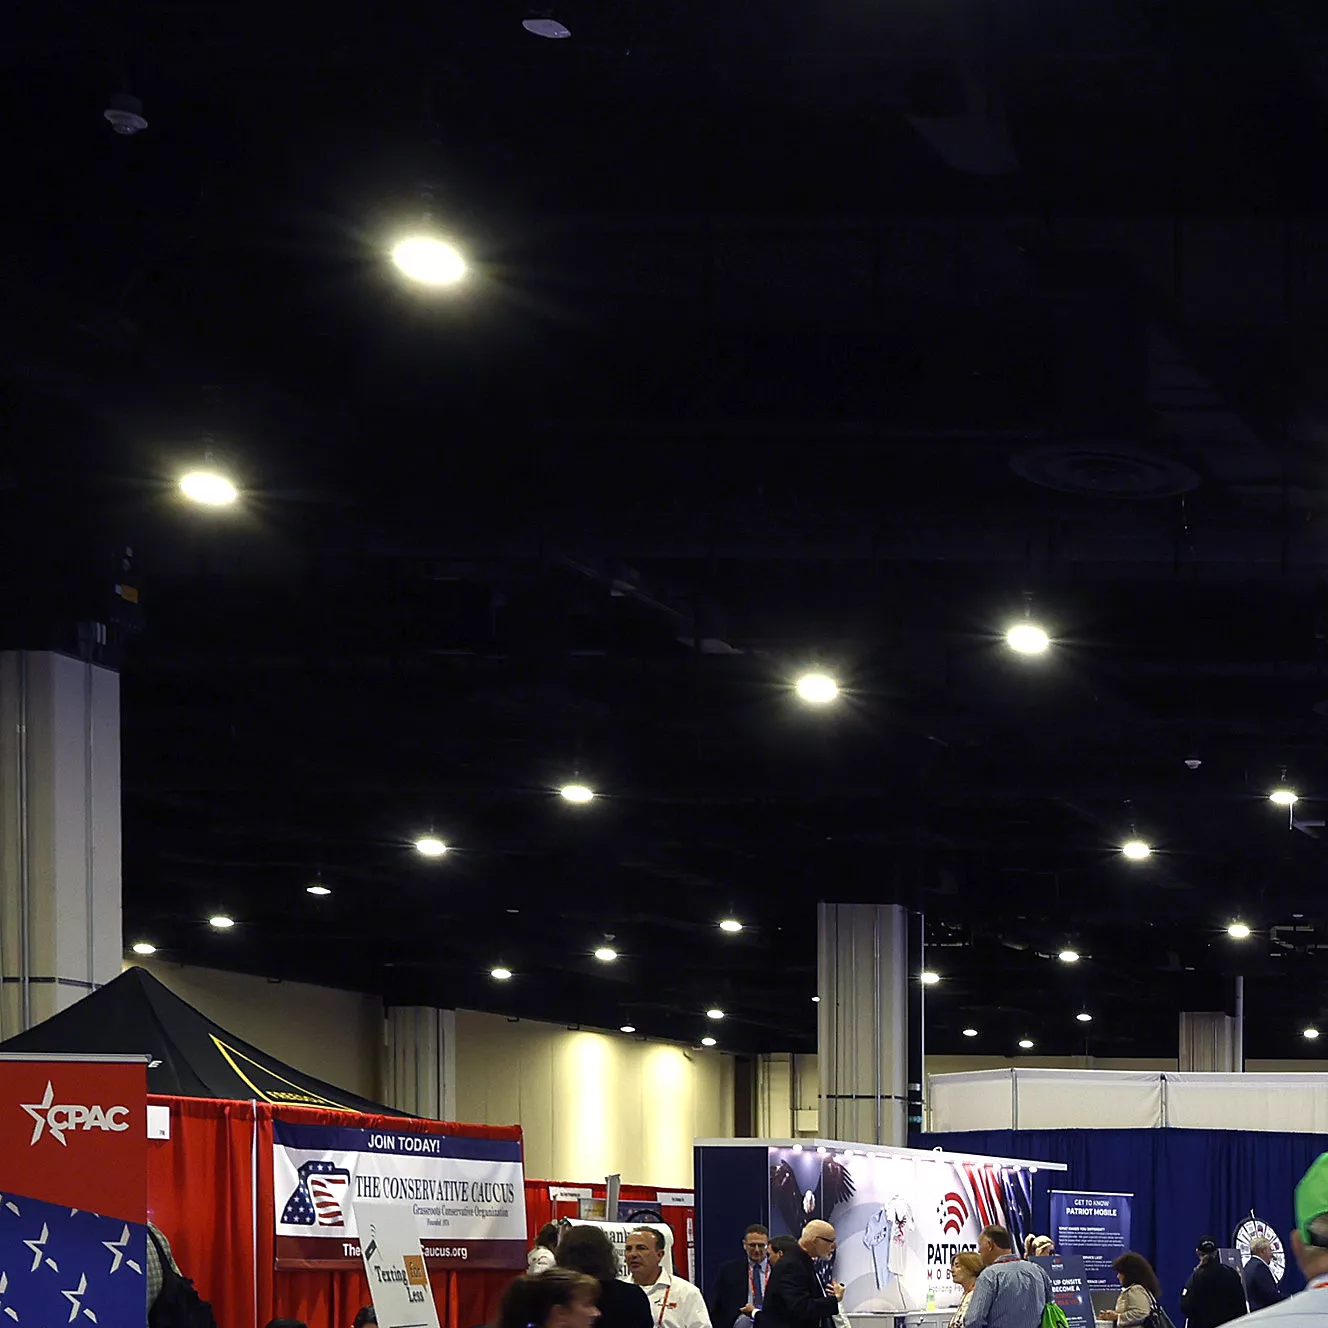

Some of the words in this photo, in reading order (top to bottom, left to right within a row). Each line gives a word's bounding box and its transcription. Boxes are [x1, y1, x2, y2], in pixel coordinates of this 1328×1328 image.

[47, 1104, 130, 1132] CPAC
[368, 1134, 396, 1150] JOIN
[398, 1137, 441, 1153] TODAY!
[356, 1175, 381, 1199] THE
[383, 1177, 470, 1202] CONSERVATIVE
[471, 1182, 515, 1204] CAUCUS
[413, 1203, 441, 1216] Grassroots
[442, 1205, 474, 1217] Conservative
[474, 1206, 509, 1220] Organization
[1066, 1208, 1093, 1216] PATRIOT
[1094, 1208, 1117, 1217] MOBILE
[374, 1265, 408, 1286] Texting
[927, 1268, 951, 1280] MOB
[407, 1286, 425, 1303] Less
